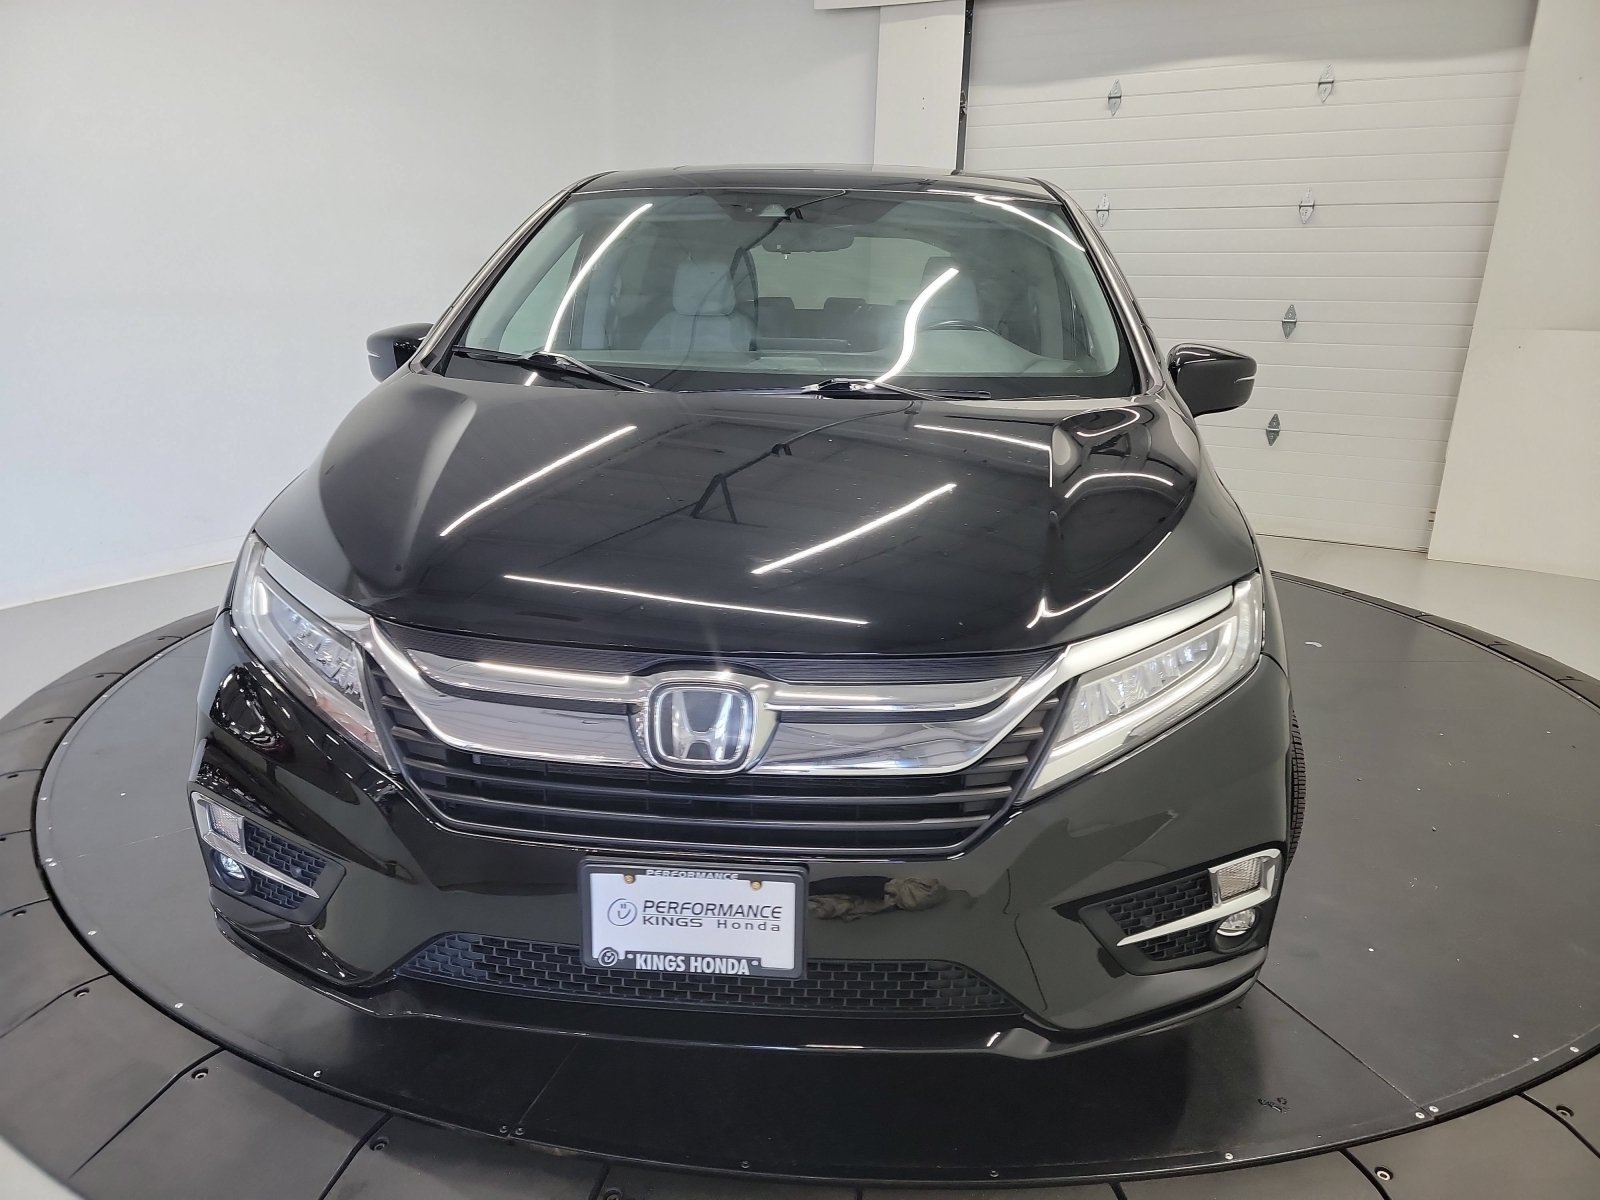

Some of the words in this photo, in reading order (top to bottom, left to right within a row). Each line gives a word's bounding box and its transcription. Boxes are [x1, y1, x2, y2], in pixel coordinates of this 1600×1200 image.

[646, 869, 739, 881] PERFORMANCE
[642, 900, 782, 919] PERFORMANCE
[642, 915, 703, 928] KINGS
[717, 919, 780, 932] Honda
[635, 953, 685, 972] KINGS
[689, 957, 750, 976] HONDA
